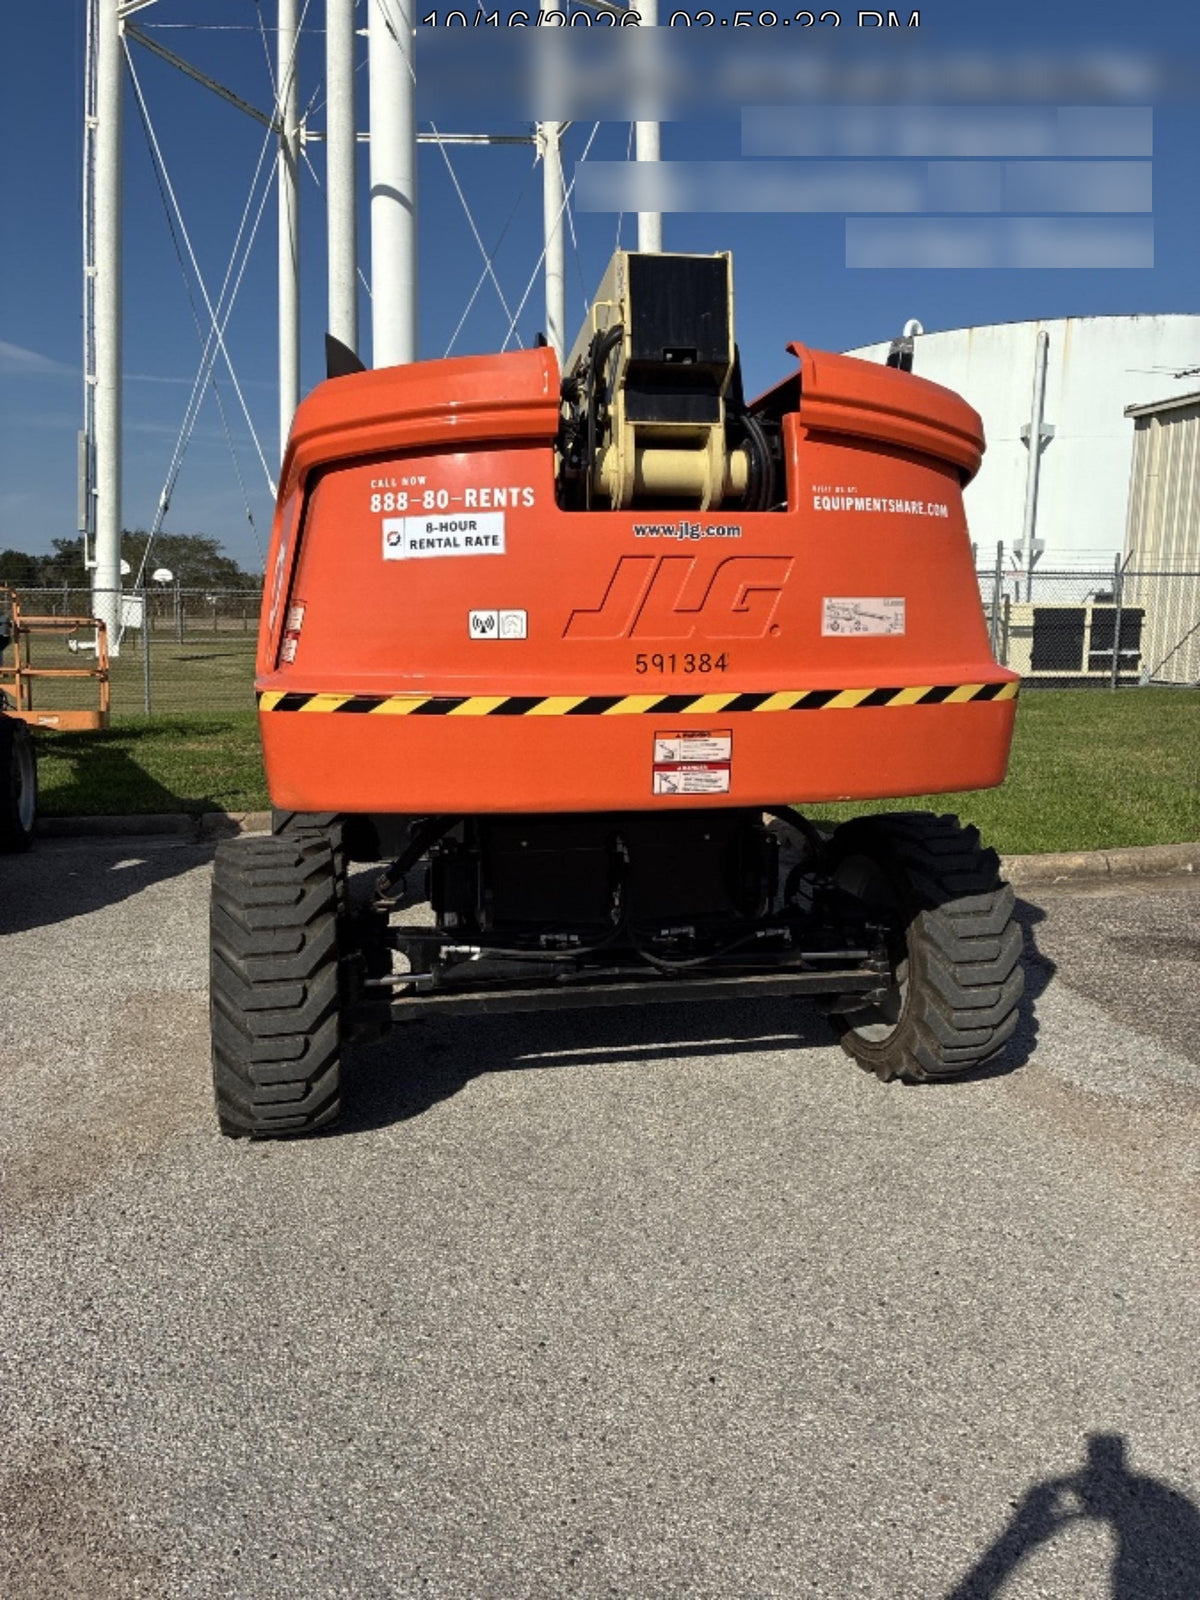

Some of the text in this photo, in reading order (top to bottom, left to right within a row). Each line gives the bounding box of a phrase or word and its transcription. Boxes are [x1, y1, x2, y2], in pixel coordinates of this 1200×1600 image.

[370, 476, 427, 488] CALL NOW
[370, 487, 535, 513] 888-80-RENTS
[813, 495, 949, 518] EQUIPMENTSHARE.COM
[426, 520, 477, 533] 8-HOUR
[633, 522, 742, 540] www.jlg.com
[410, 534, 499, 550] RENTAL RATE
[635, 653, 729, 673] 591384
